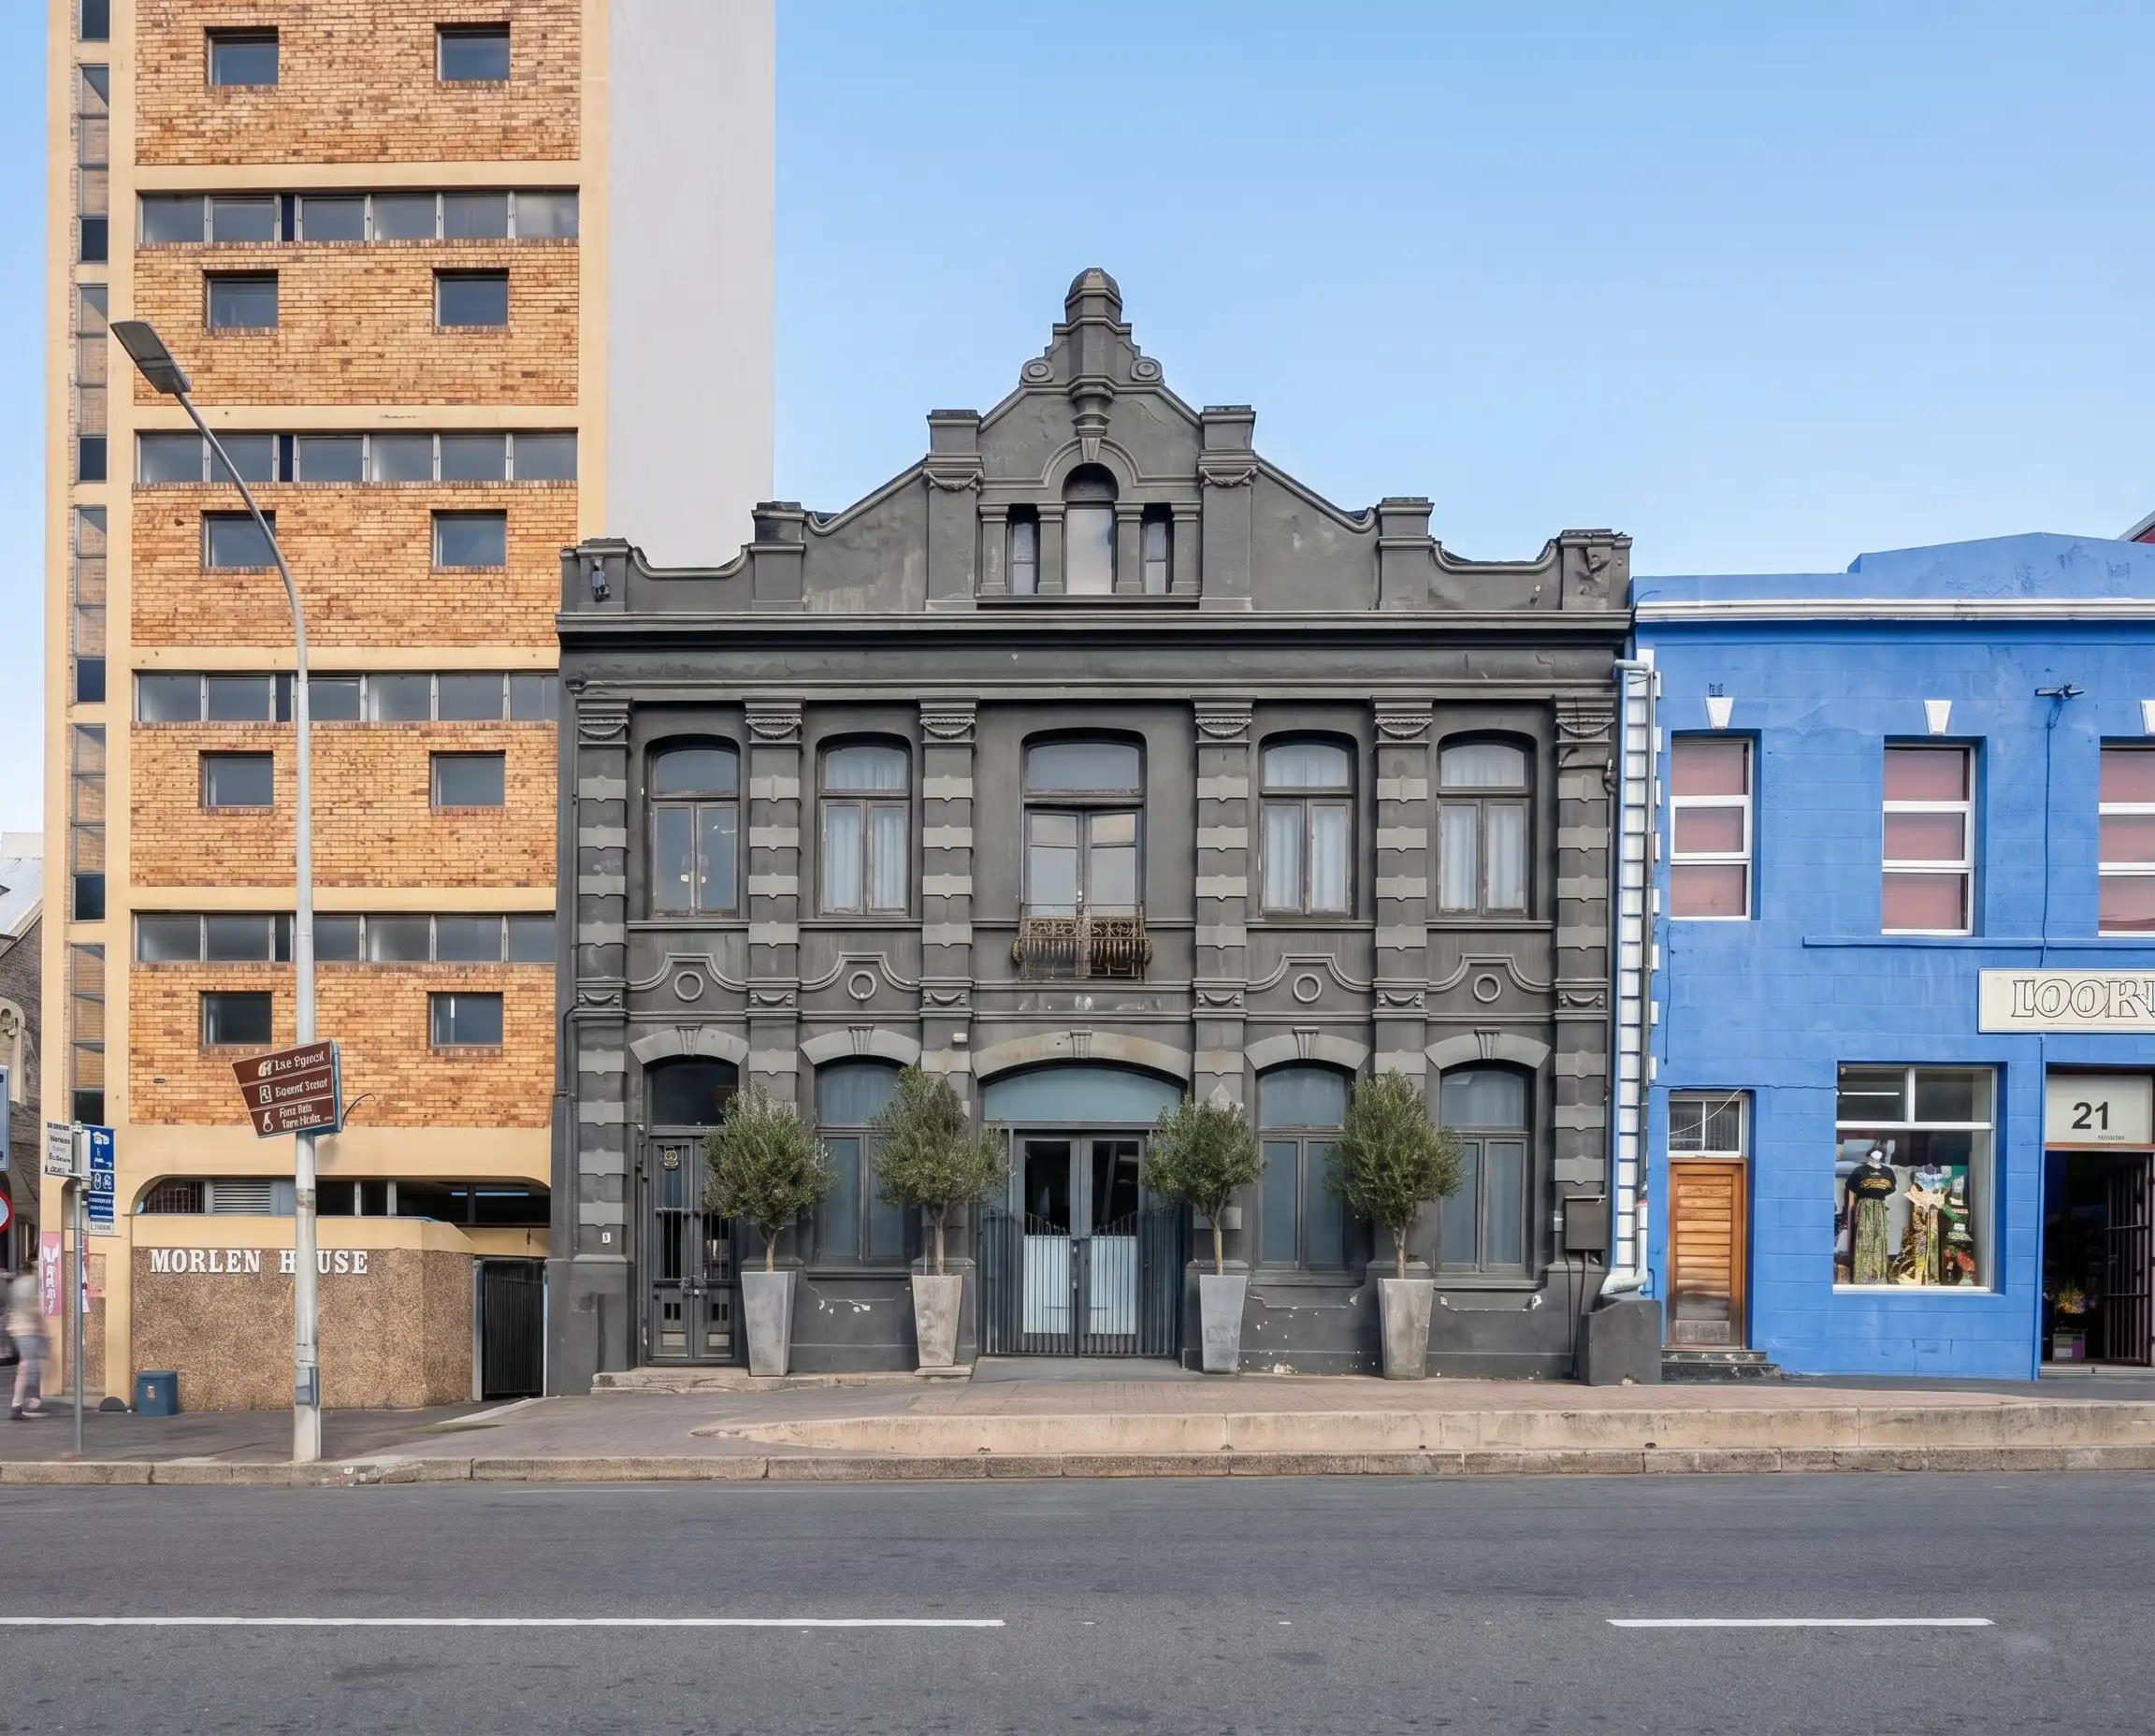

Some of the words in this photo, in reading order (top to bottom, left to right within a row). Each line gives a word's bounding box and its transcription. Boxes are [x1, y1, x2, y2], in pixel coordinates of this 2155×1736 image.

[2072, 1101, 2108, 1130] 21
[150, 1249, 262, 1274] MORLEN
[279, 1250, 369, 1275] HUSE
